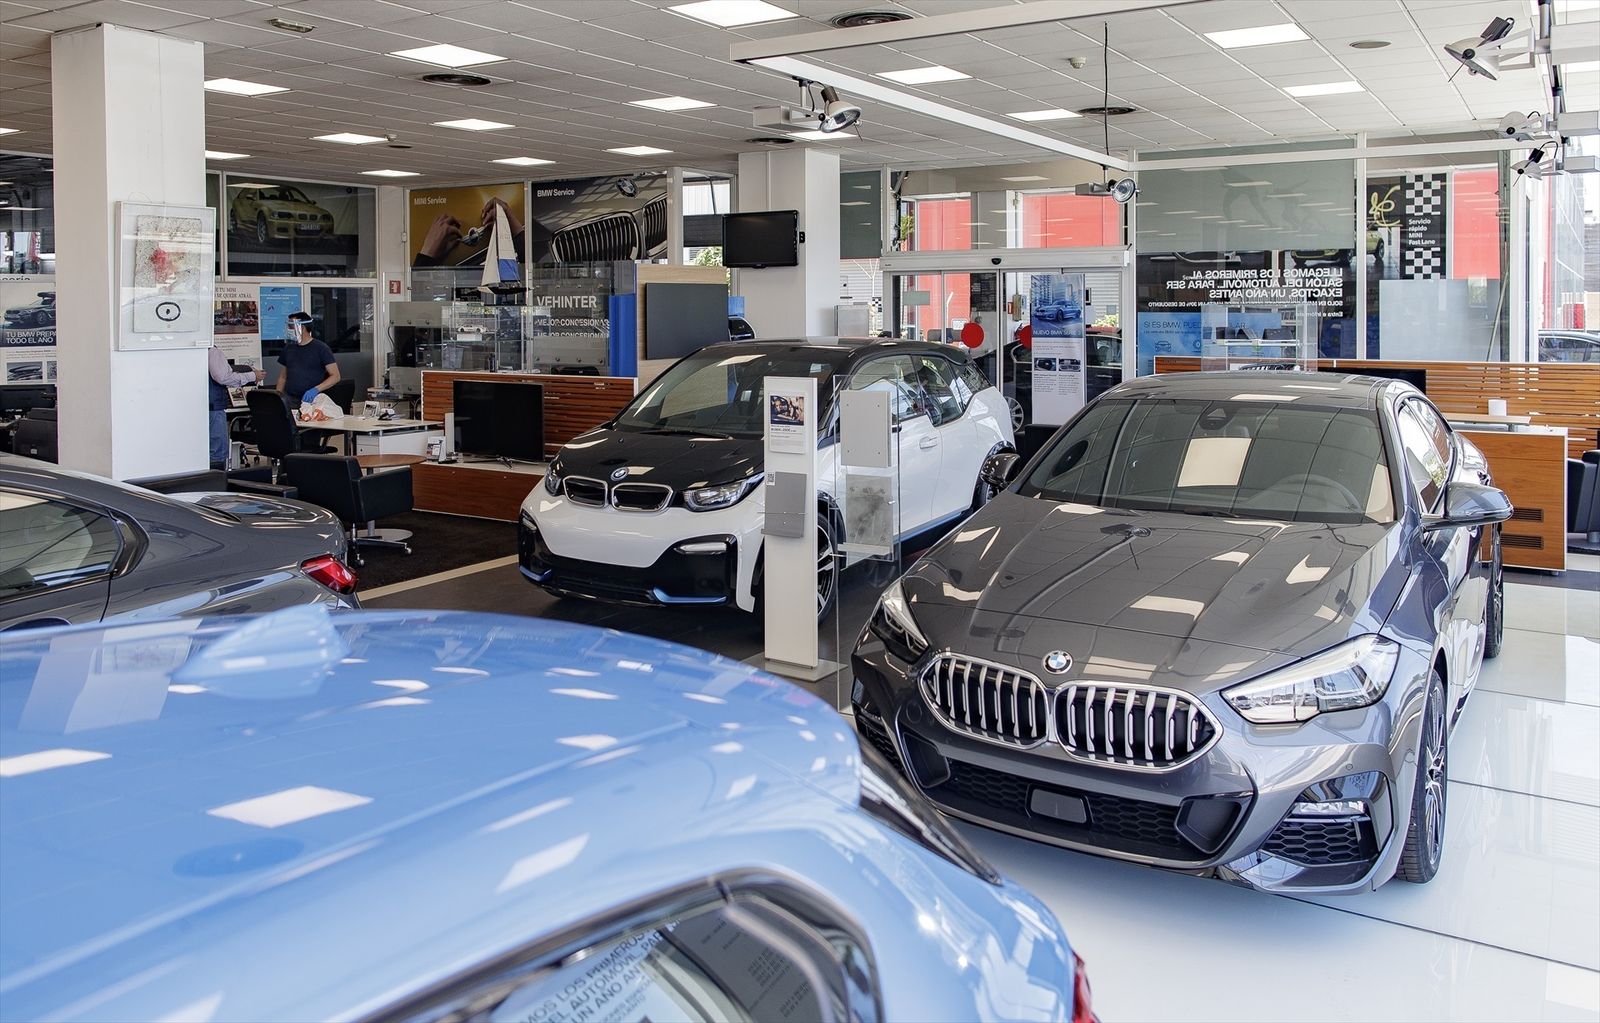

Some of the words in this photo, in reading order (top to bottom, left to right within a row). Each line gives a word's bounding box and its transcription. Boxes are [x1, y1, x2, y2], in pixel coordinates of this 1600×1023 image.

[553, 188, 575, 197] Service
[414, 197, 427, 206] MINI
[427, 195, 447, 205] Service
[536, 295, 597, 308] VEHINTER
[1151, 321, 1161, 329] ES
